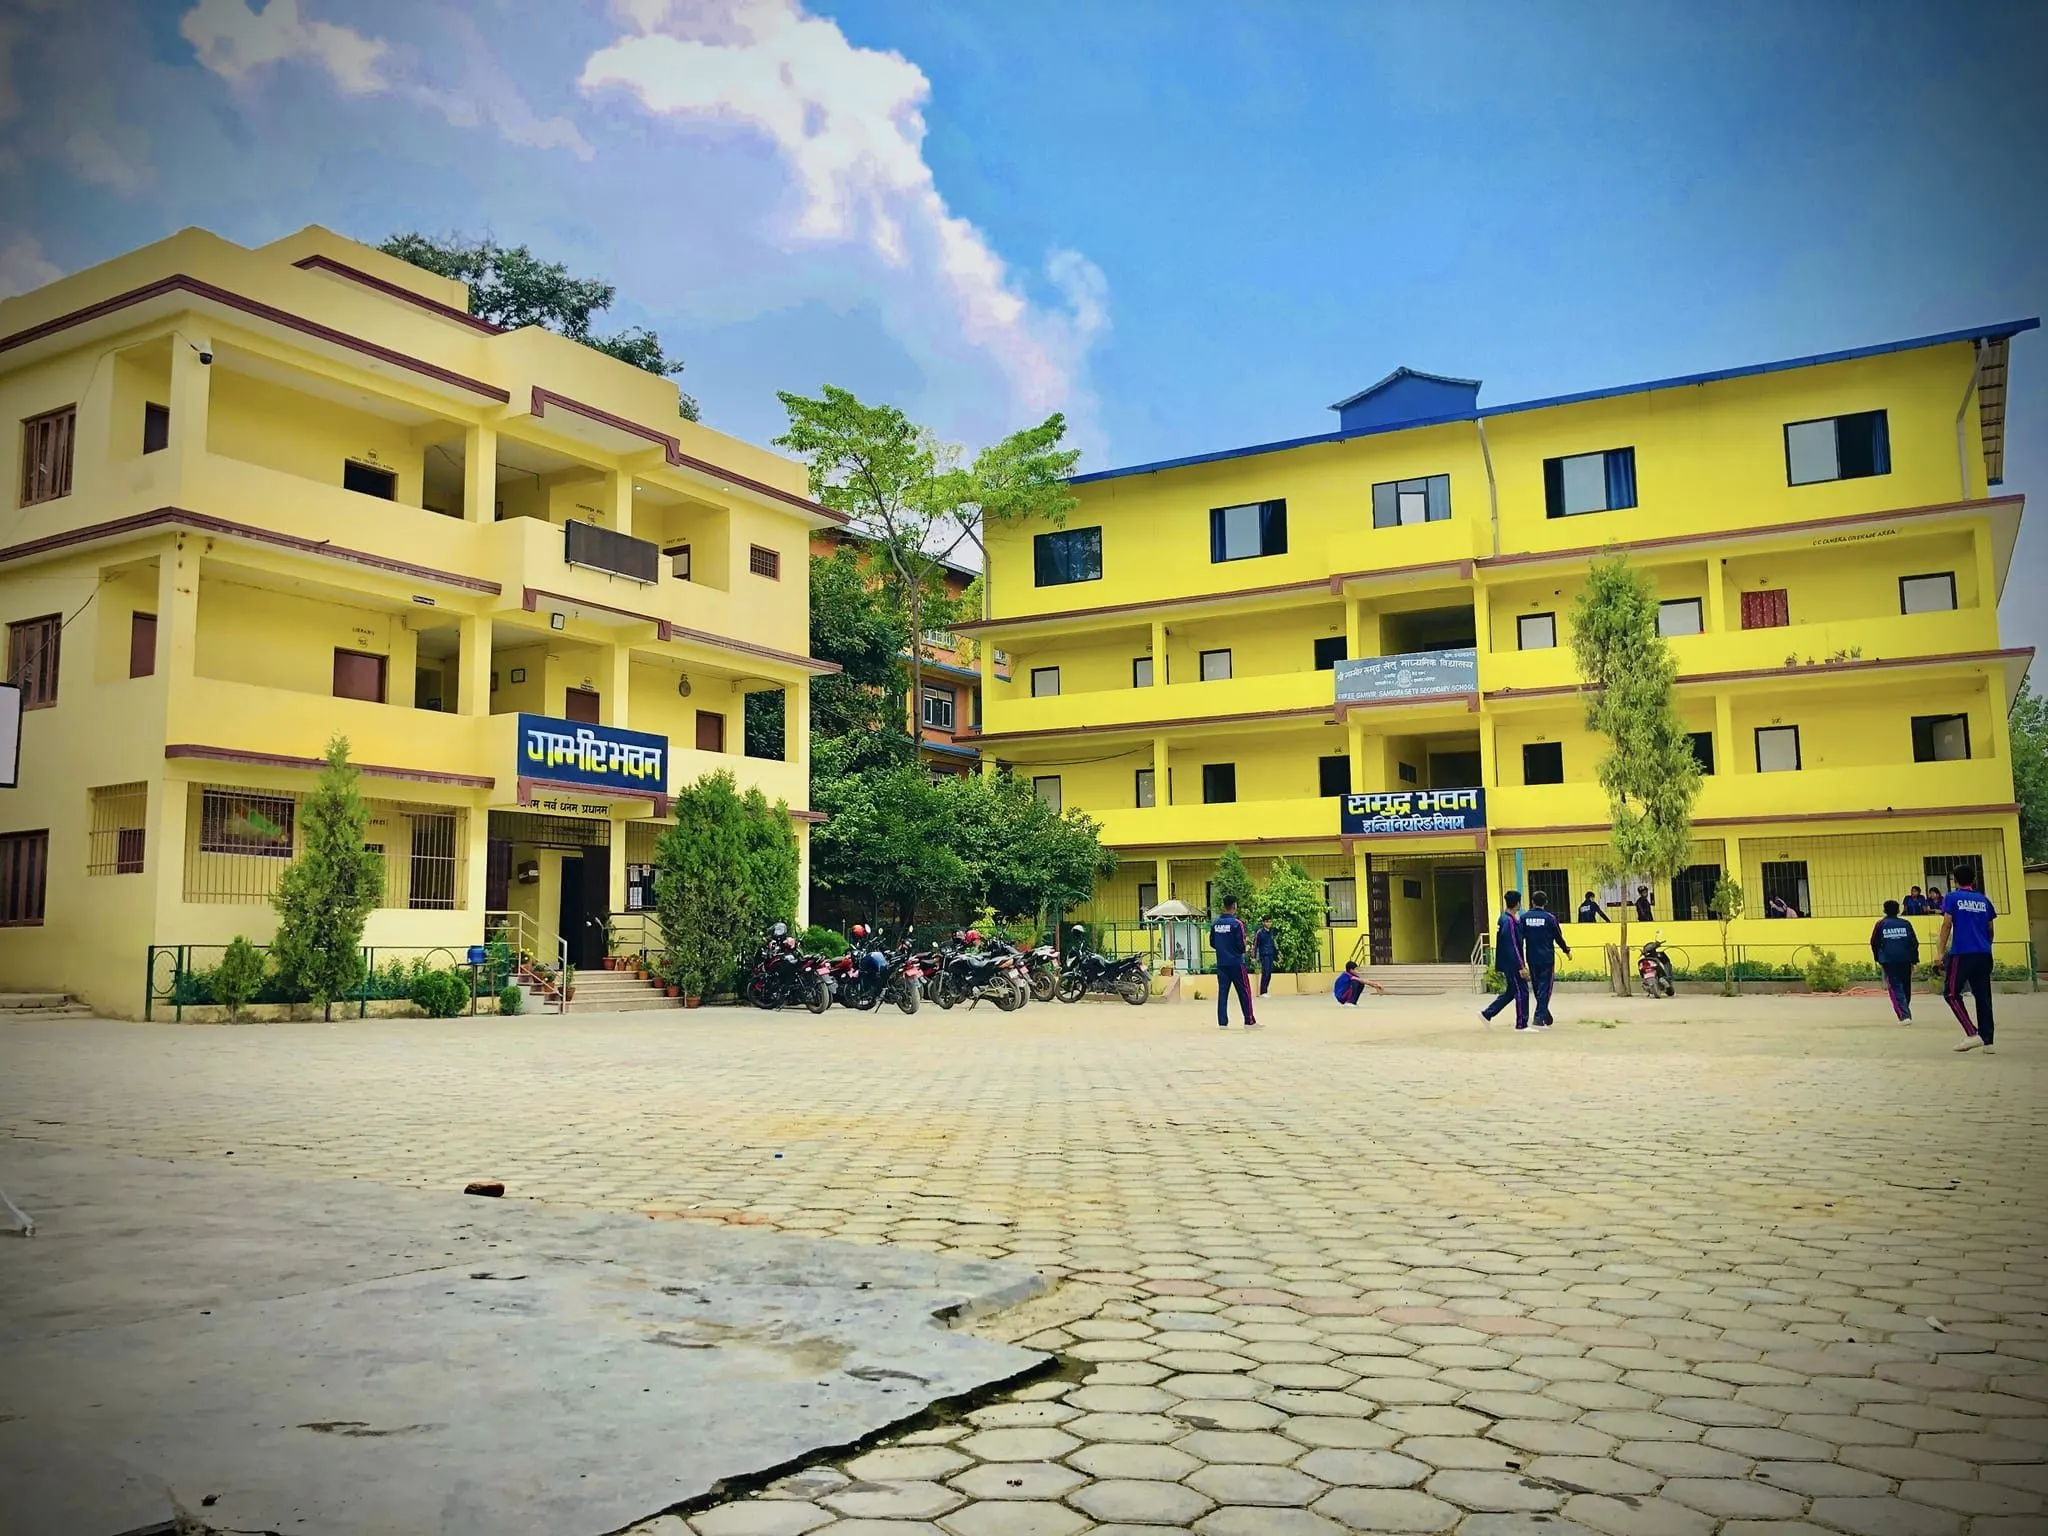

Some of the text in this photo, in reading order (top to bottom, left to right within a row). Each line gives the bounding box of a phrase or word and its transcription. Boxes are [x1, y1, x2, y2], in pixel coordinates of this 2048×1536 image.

[527, 728, 663, 782] गम्भीर भवन
[1348, 789, 1478, 816] समुद्र भवन
[1433, 812, 1466, 830] विभाग
[1957, 900, 1986, 910] GAMVIR
[1883, 928, 1907, 936] GAMVIR
